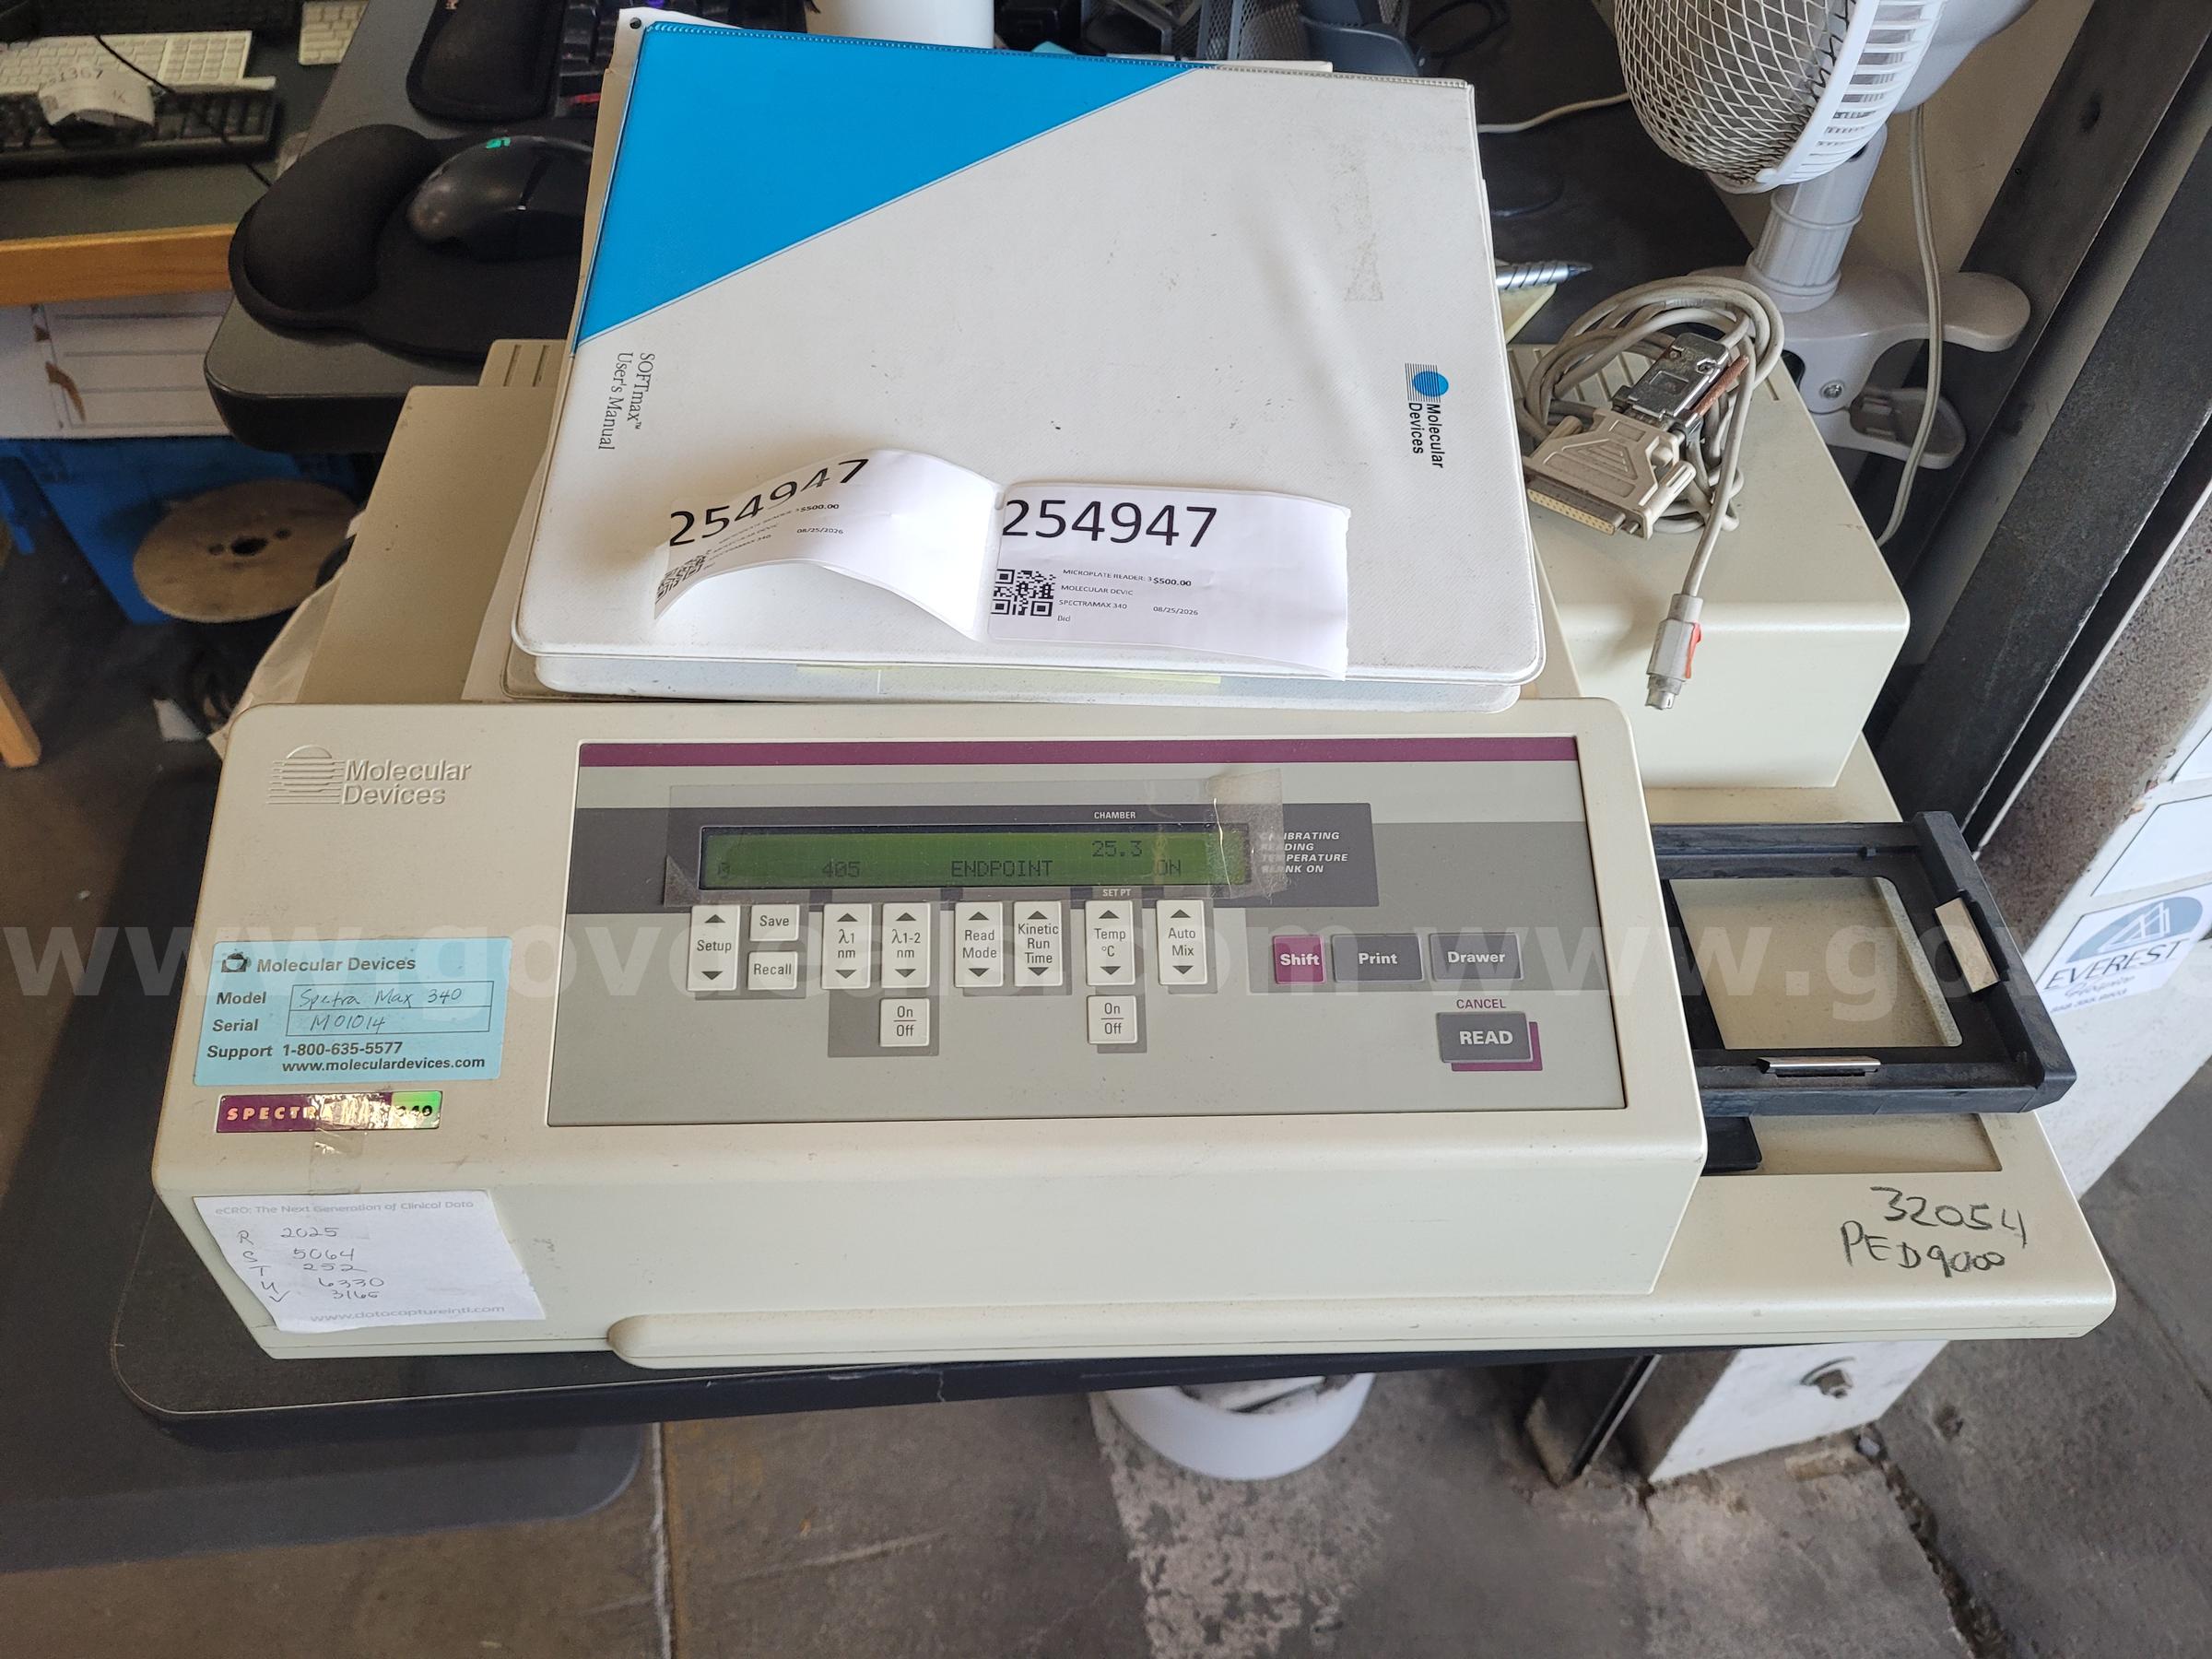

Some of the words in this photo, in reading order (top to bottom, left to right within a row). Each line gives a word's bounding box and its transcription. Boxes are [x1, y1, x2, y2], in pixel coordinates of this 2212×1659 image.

[611, 352, 633, 393] User's
[598, 396, 624, 450] Manual
[1408, 402, 1425, 454] Devices
[1426, 403, 1445, 468] Molecular
[669, 459, 869, 547] 254947
[800, 503, 840, 512] $500.00
[1002, 499, 1218, 547] 254947
[1063, 569, 1112, 579] MICROPLATE
[1153, 577, 1192, 587] $500.00
[1061, 584, 1109, 594] MOLECULAR
[1059, 599, 1112, 608] SPECTRAMAX
[1153, 606, 1198, 616] 08/25/2026
[345, 759, 472, 782] Molecular
[341, 783, 446, 805] Devices
[1094, 811, 1136, 819] CHAMBER
[1091, 840, 1143, 857] 25.3
[822, 861, 861, 878] 405
[950, 860, 1053, 877] ENDPOINT
[1157, 859, 1182, 877] ON
[1306, 865, 1324, 873] ON
[1102, 888, 1118, 897] SET
[1120, 888, 1132, 897] PT
[759, 915, 790, 926] Save
[964, 930, 995, 941] Read
[1018, 924, 1059, 935] Kinetic
[1094, 928, 1126, 942] Temp
[1168, 927, 1196, 939] Auto
[696, 940, 732, 953] Setup
[1027, 938, 1050, 949] Run
[837, 948, 856, 959] nm
[897, 948, 915, 959] nm
[962, 947, 997, 959] Mode
[1101, 946, 1116, 958] °C
[1171, 945, 1194, 957] Mix
[1447, 951, 1506, 963] Drawer
[256, 959, 343, 972] Molecular
[347, 958, 417, 971] Devices
[1025, 953, 1053, 964] Time
[1280, 953, 1320, 966] Shift
[1358, 952, 1398, 965] Print
[2044, 937, 2191, 990] EVEREST
[753, 963, 792, 975] Recall
[216, 992, 267, 1005] Model
[374, 988, 414, 1008] Max
[428, 988, 462, 1005] 340
[1456, 998, 1507, 1009] CANCEL
[897, 1006, 914, 1018] On
[1103, 1003, 1121, 1015] On
[212, 1018, 259, 1032] Serial
[896, 1024, 914, 1038] Off
[1104, 1022, 1122, 1035] Off
[1459, 1030, 1513, 1045] READ
[207, 1045, 274, 1061] Support
[282, 1041, 403, 1056] 1-800-635-5577
[282, 1057, 485, 1073] www.moleculardevices.com
[227, 1107, 333, 1122] SPECTRA
[254, 1206, 277, 1214] The
[313, 1203, 382, 1213] Generation
[384, 1202, 396, 1211] of
[400, 1201, 441, 1210] Clinical
[445, 1201, 474, 1209] Data
[1870, 1186, 2028, 1249] 32054
[238, 1230, 254, 1244] R
[280, 1227, 339, 1238] 2025
[242, 1251, 258, 1263] S
[292, 1248, 355, 1261] 5064
[249, 1265, 271, 1277] T
[303, 1263, 367, 1273] 252
[318, 1277, 384, 1288] 6330
